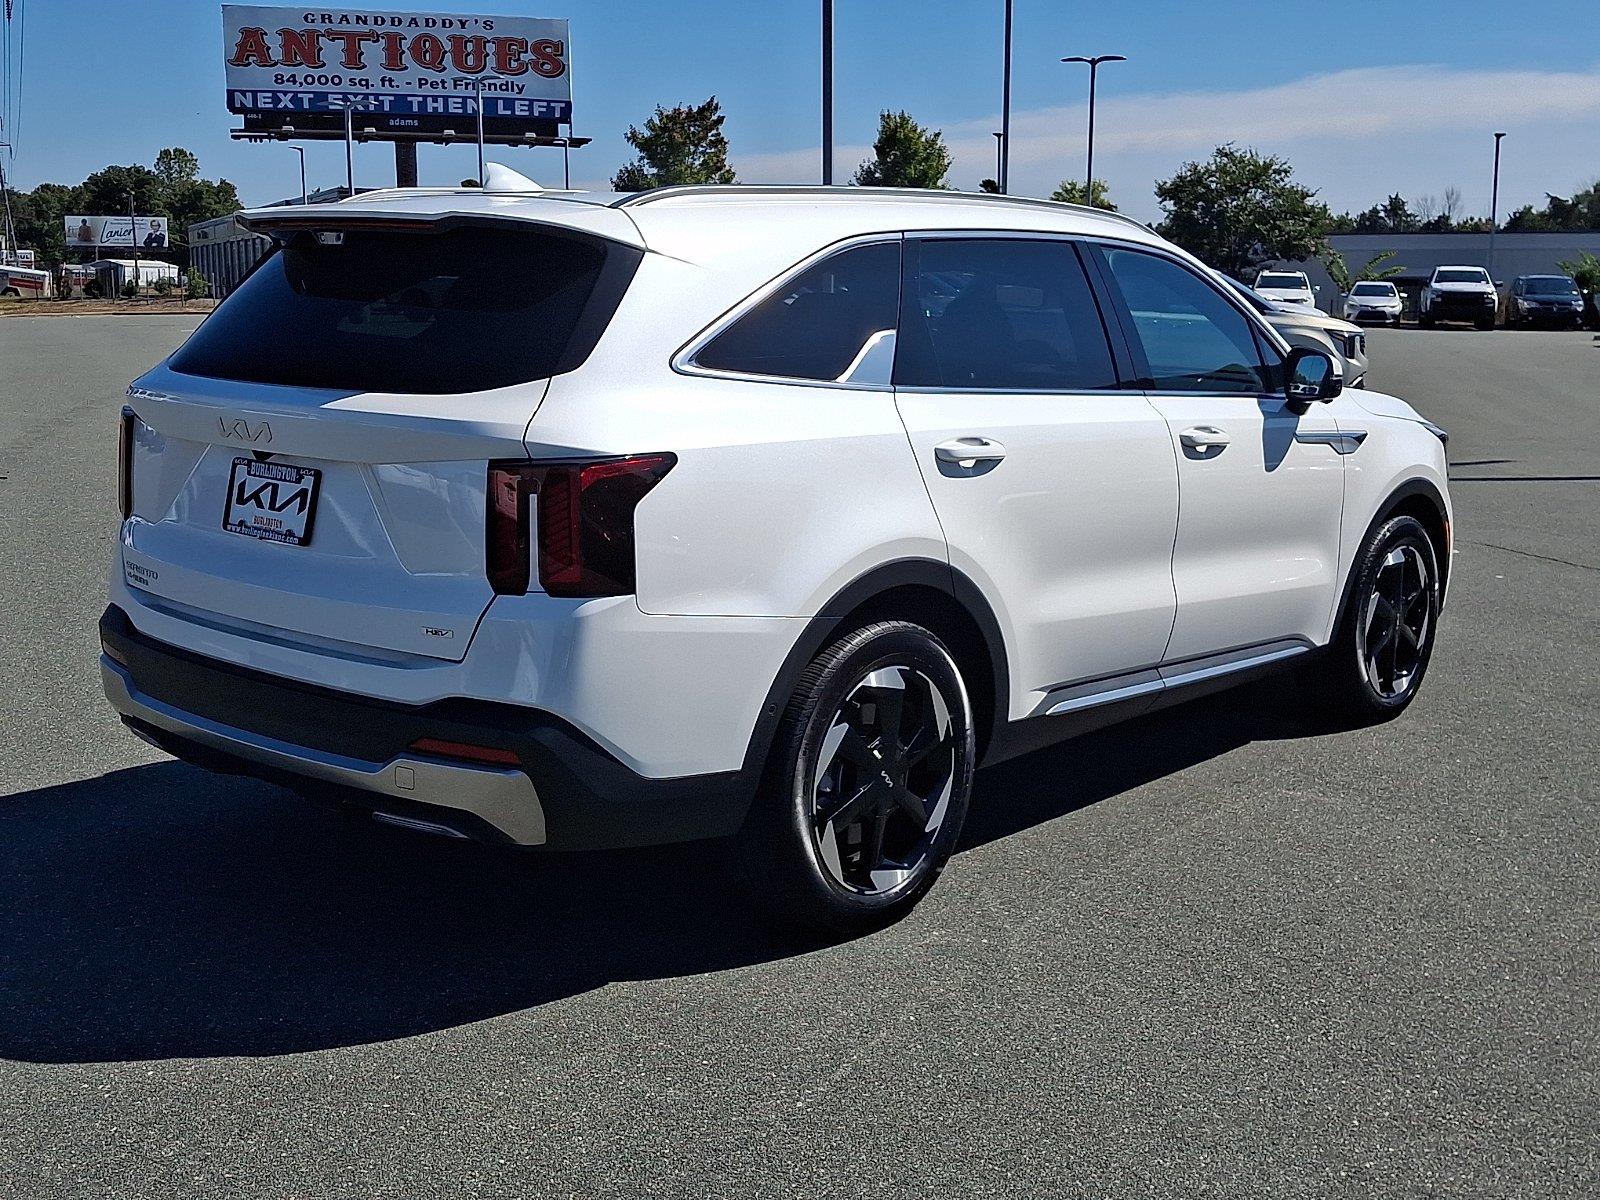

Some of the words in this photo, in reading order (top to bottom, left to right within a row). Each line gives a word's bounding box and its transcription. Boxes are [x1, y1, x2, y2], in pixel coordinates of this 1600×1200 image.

[303, 12, 495, 31] GRANDDADDY'S
[227, 27, 567, 78] ANTIQUES
[273, 73, 343, 88] 84,000
[348, 77, 375, 89] sq.
[379, 76, 400, 88] ft.
[418, 78, 448, 90] Pet
[234, 91, 314, 109] NEXT
[407, 97, 484, 114] THEN
[497, 99, 566, 117] LEFT
[389, 117, 419, 127] adams
[219, 416, 273, 443] KIA
[250, 462, 297, 482] BURLINGTON
[235, 478, 309, 516] KIA
